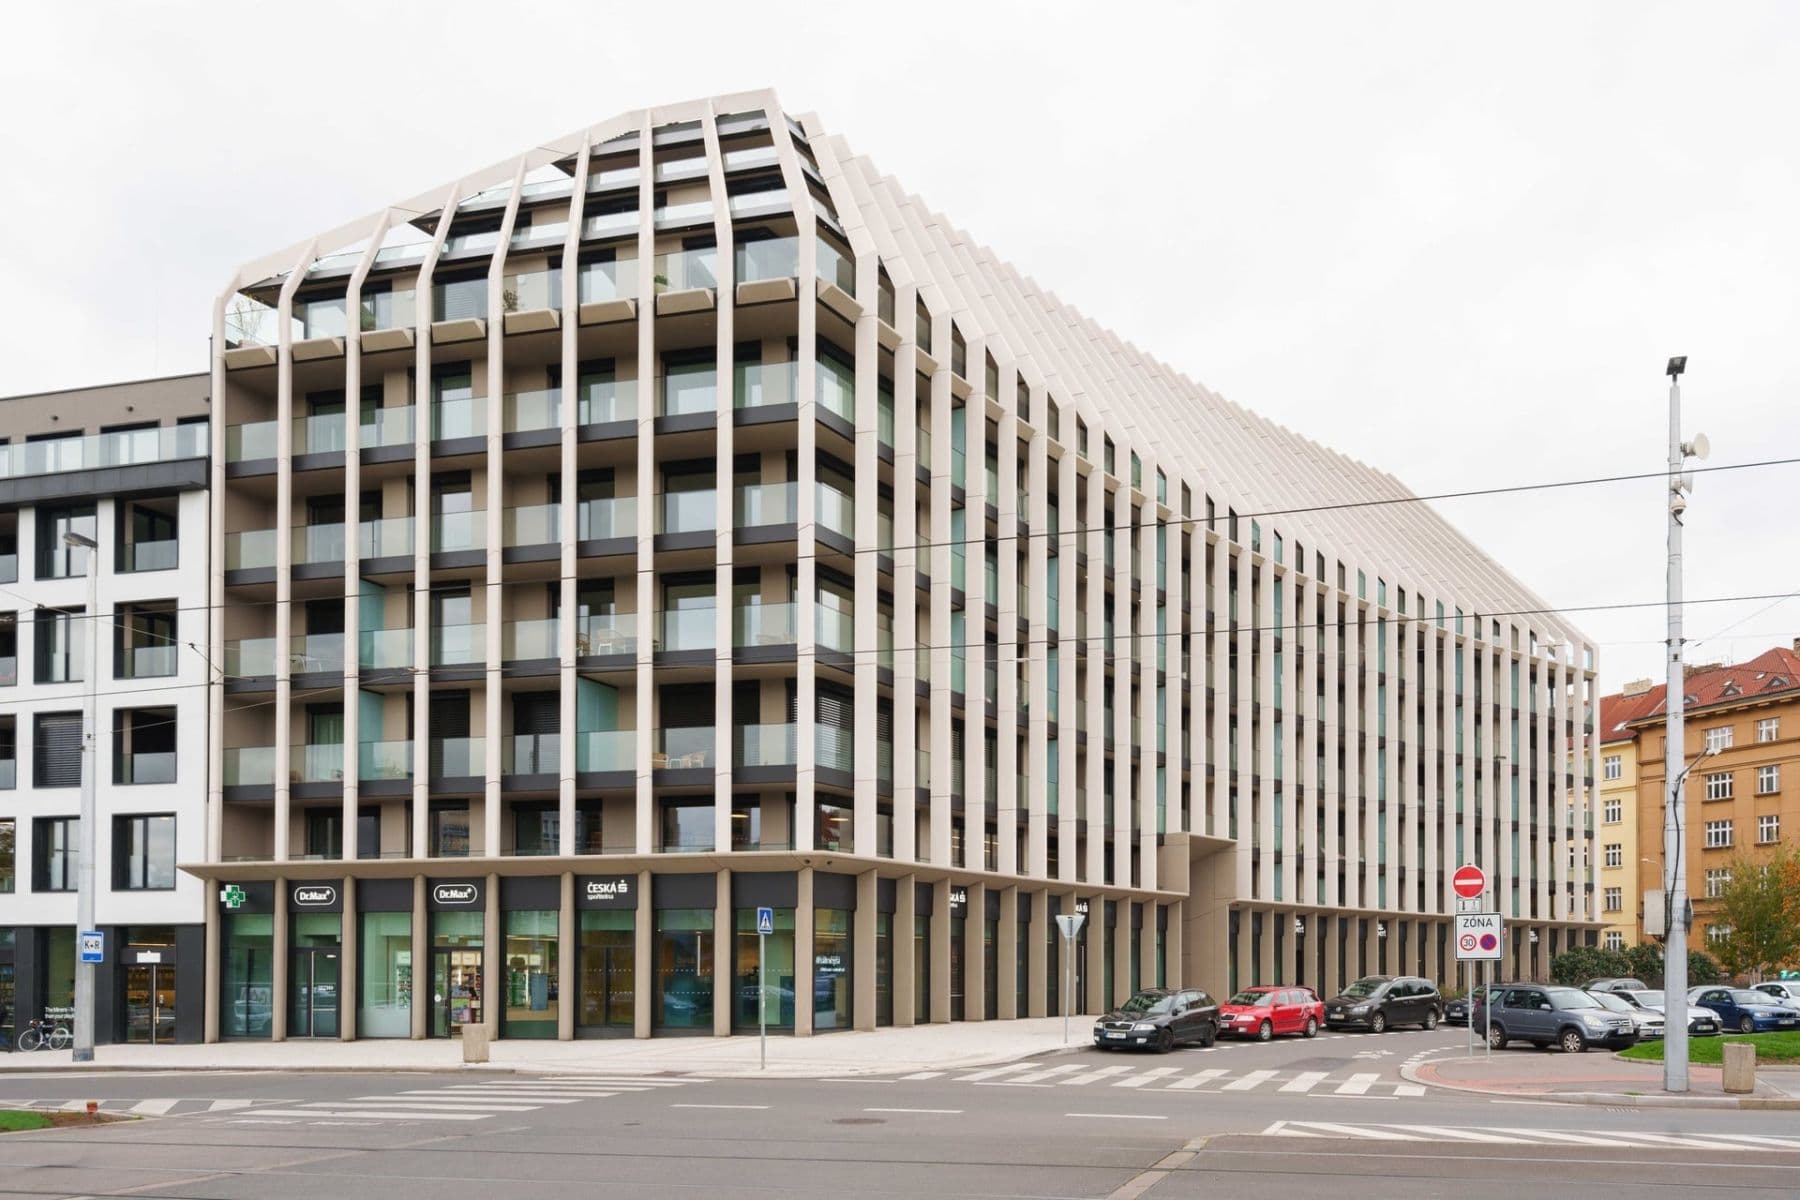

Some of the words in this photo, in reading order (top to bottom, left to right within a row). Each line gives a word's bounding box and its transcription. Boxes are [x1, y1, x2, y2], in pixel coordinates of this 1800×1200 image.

[587, 881, 617, 894] ČESKÁ
[1463, 914, 1494, 928] ZÓNA
[1463, 938, 1474, 947] 30
